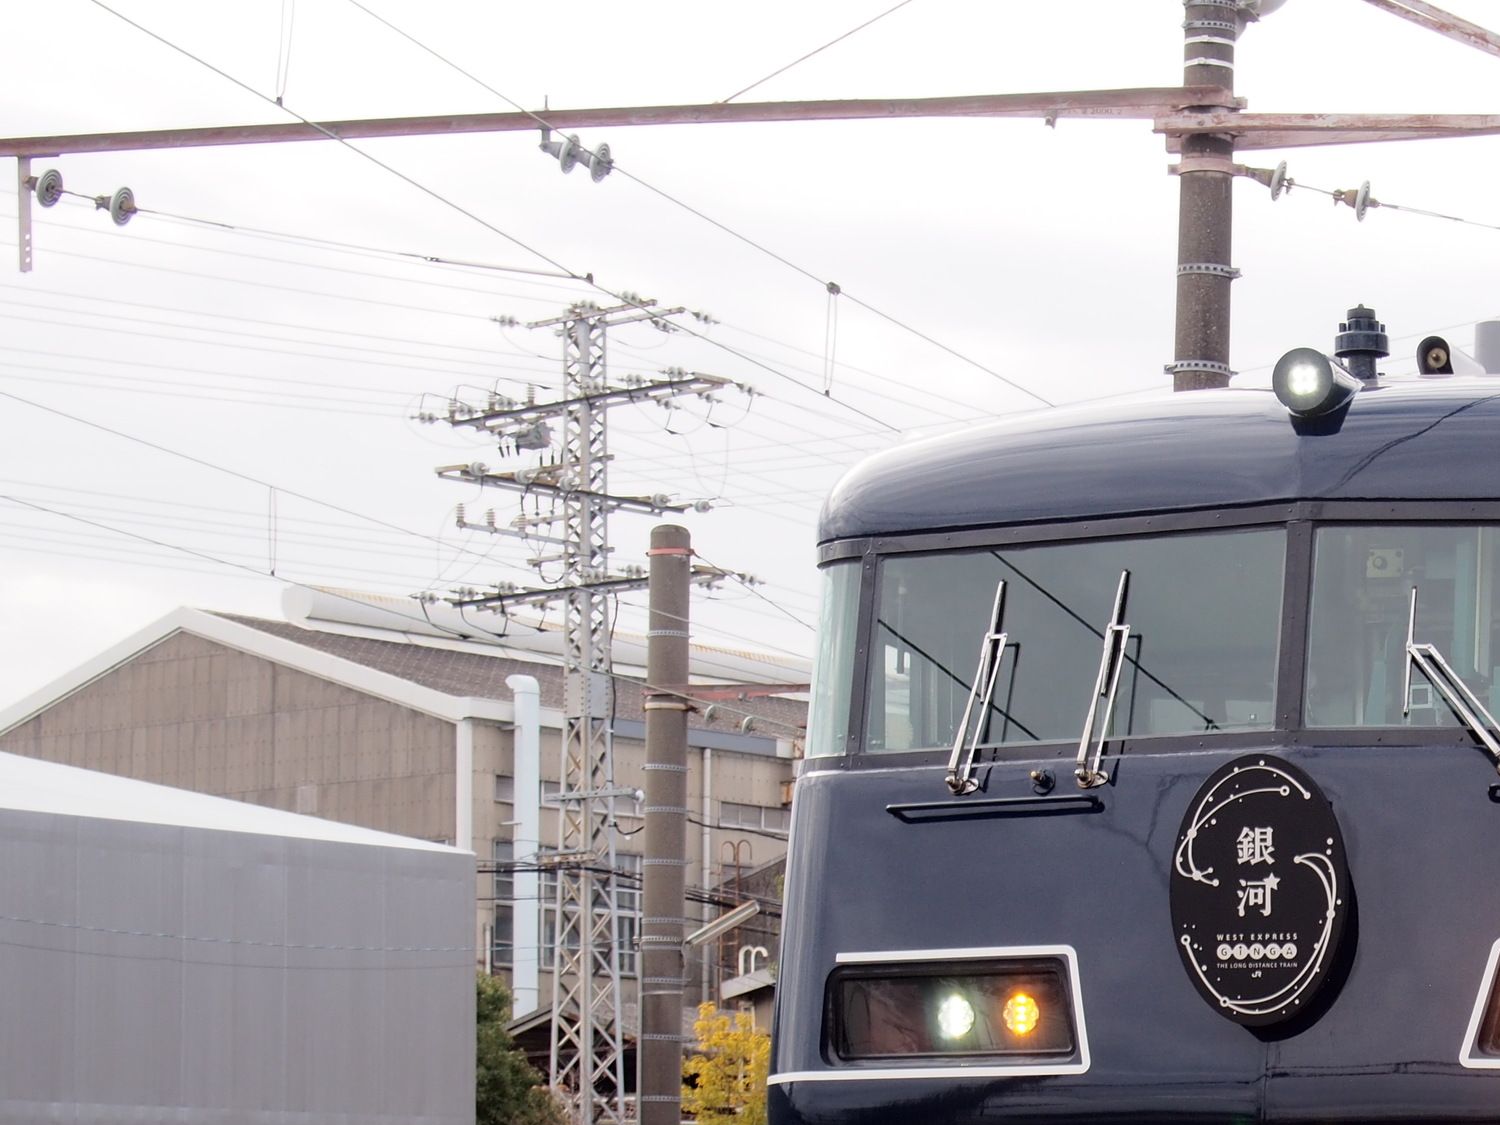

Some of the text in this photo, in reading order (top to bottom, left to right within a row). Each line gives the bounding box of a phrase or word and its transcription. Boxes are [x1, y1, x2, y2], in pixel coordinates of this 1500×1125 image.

[1236, 827, 1281, 917] 銀河
[1216, 932, 1298, 941] WEST EXPRESS
[1251, 970, 1262, 978] JR
